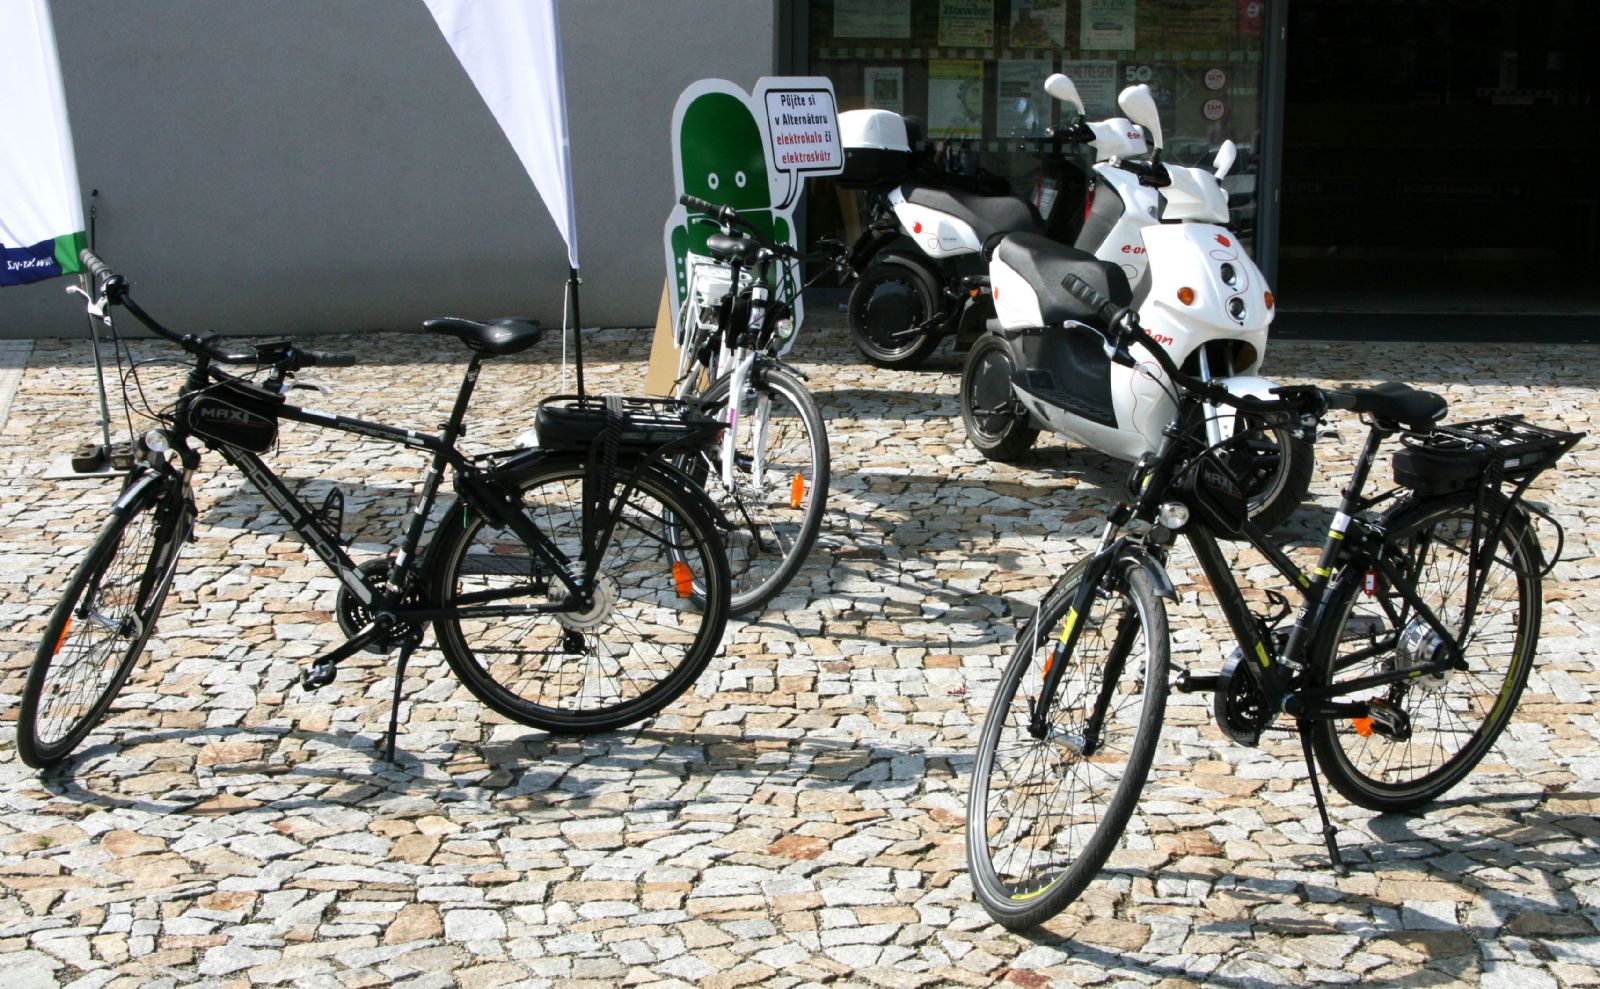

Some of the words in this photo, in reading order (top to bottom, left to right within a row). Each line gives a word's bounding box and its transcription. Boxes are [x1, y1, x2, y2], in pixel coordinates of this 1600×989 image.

[1125, 65, 1153, 82] 50
[780, 94, 806, 109] Půjčte
[808, 94, 816, 106] si
[774, 116, 780, 126] v
[782, 113, 828, 126] Alternátoru
[776, 131, 823, 145] elektrokolo
[825, 130, 832, 143] či
[782, 150, 831, 164] elektroskútr
[225, 444, 302, 523] EADER
[300, 523, 351, 577] FOX
